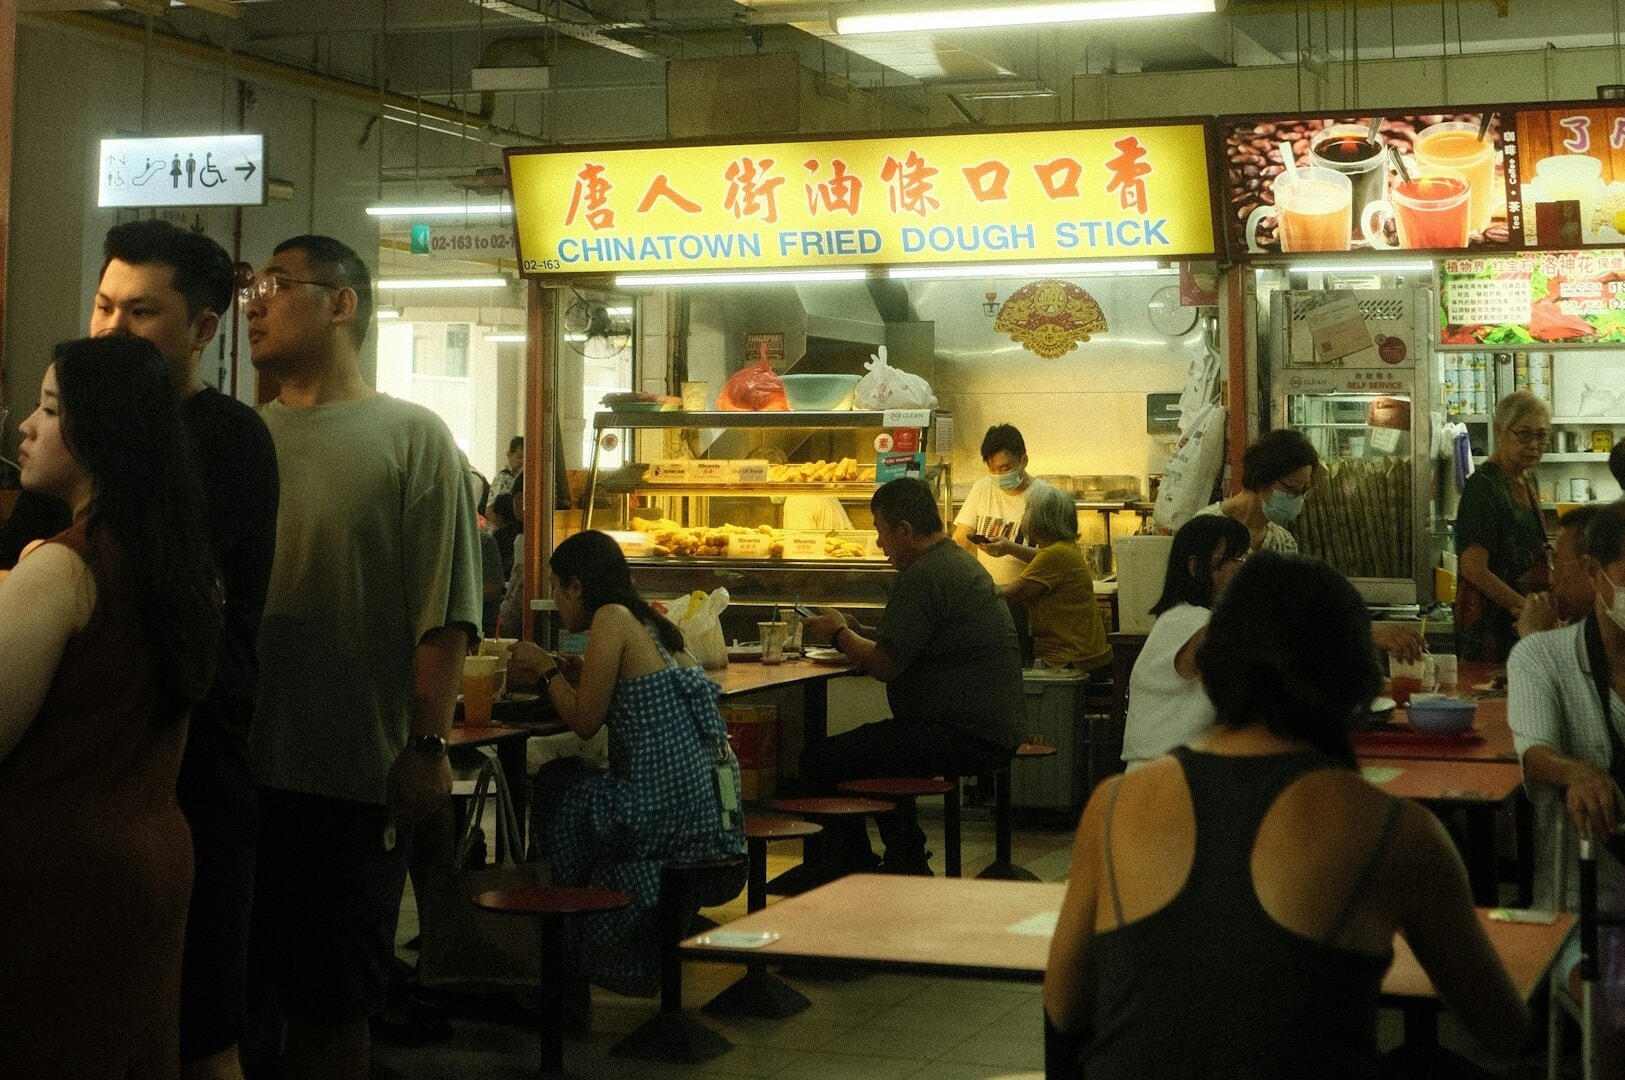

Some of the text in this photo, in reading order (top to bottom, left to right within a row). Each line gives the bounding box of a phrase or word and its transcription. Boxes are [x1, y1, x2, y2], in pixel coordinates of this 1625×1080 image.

[1508, 158, 1517, 185] Coffee
[564, 137, 1153, 230] 唐人街油條口口香
[1508, 201, 1520, 213] 茶
[1512, 215, 1520, 230] Tea
[432, 235, 472, 251] 02-163
[475, 235, 490, 248] to
[558, 218, 1170, 264] CHINATOWN FRIED DOUGH STICK
[523, 259, 561, 271] 02-163
[1446, 260, 1486, 274] 植物界
[1492, 259, 1533, 274] 红宝石
[1542, 254, 1595, 275] 洛神花
[1346, 381, 1403, 389] SELF SERVICE
